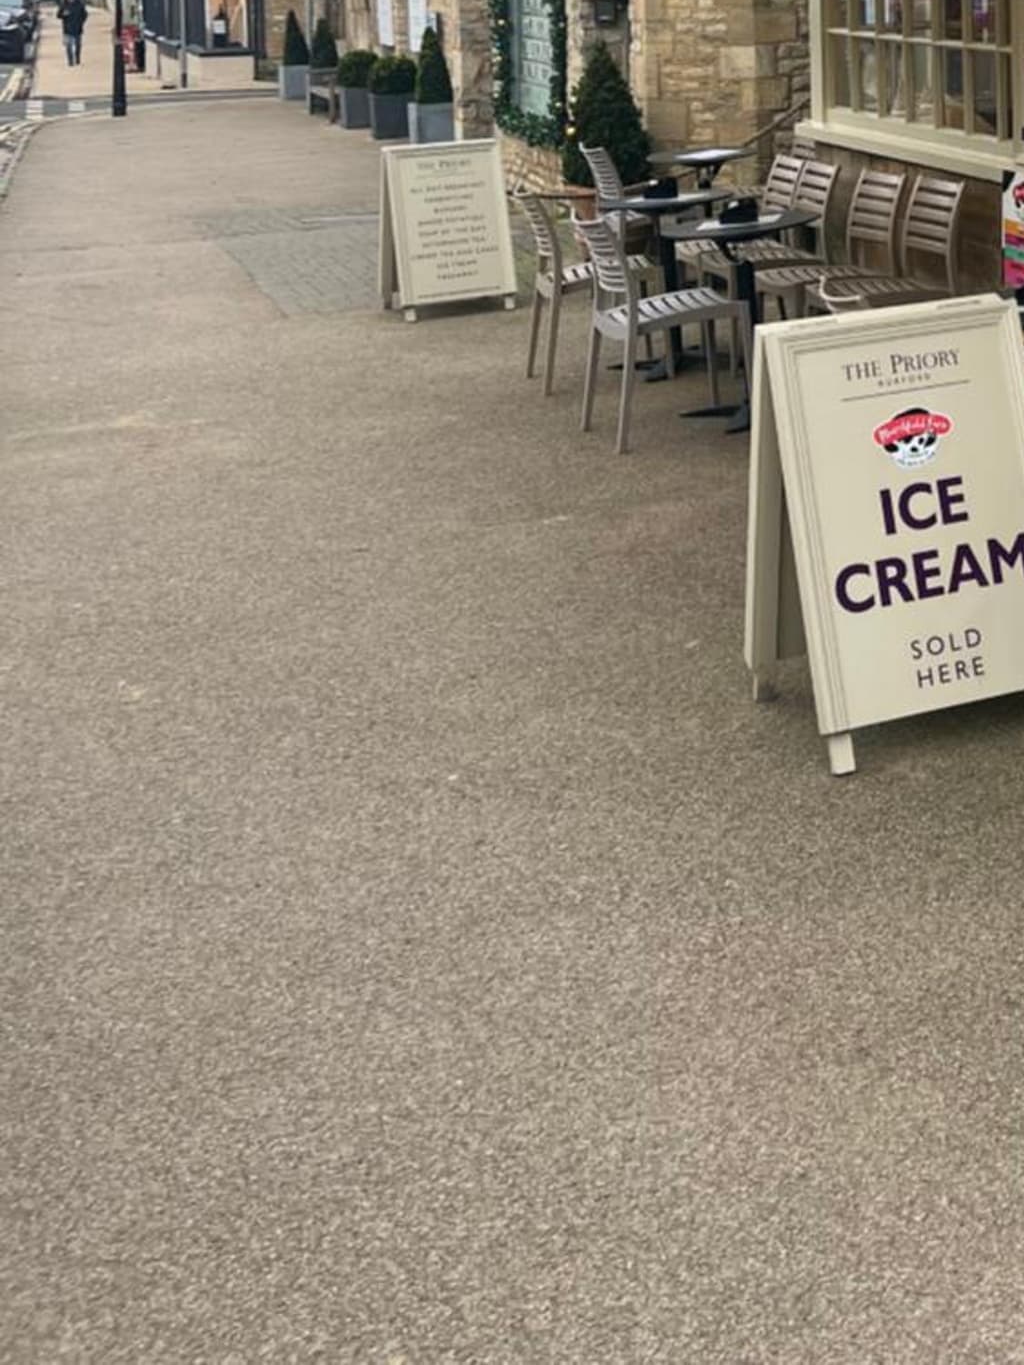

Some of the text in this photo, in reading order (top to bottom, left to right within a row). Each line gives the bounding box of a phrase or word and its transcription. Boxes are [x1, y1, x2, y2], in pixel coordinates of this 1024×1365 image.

[841, 348, 961, 382] THE PRIORY
[879, 476, 968, 536] ICE
[910, 628, 983, 660] SOLD
[917, 656, 986, 689] HERE
